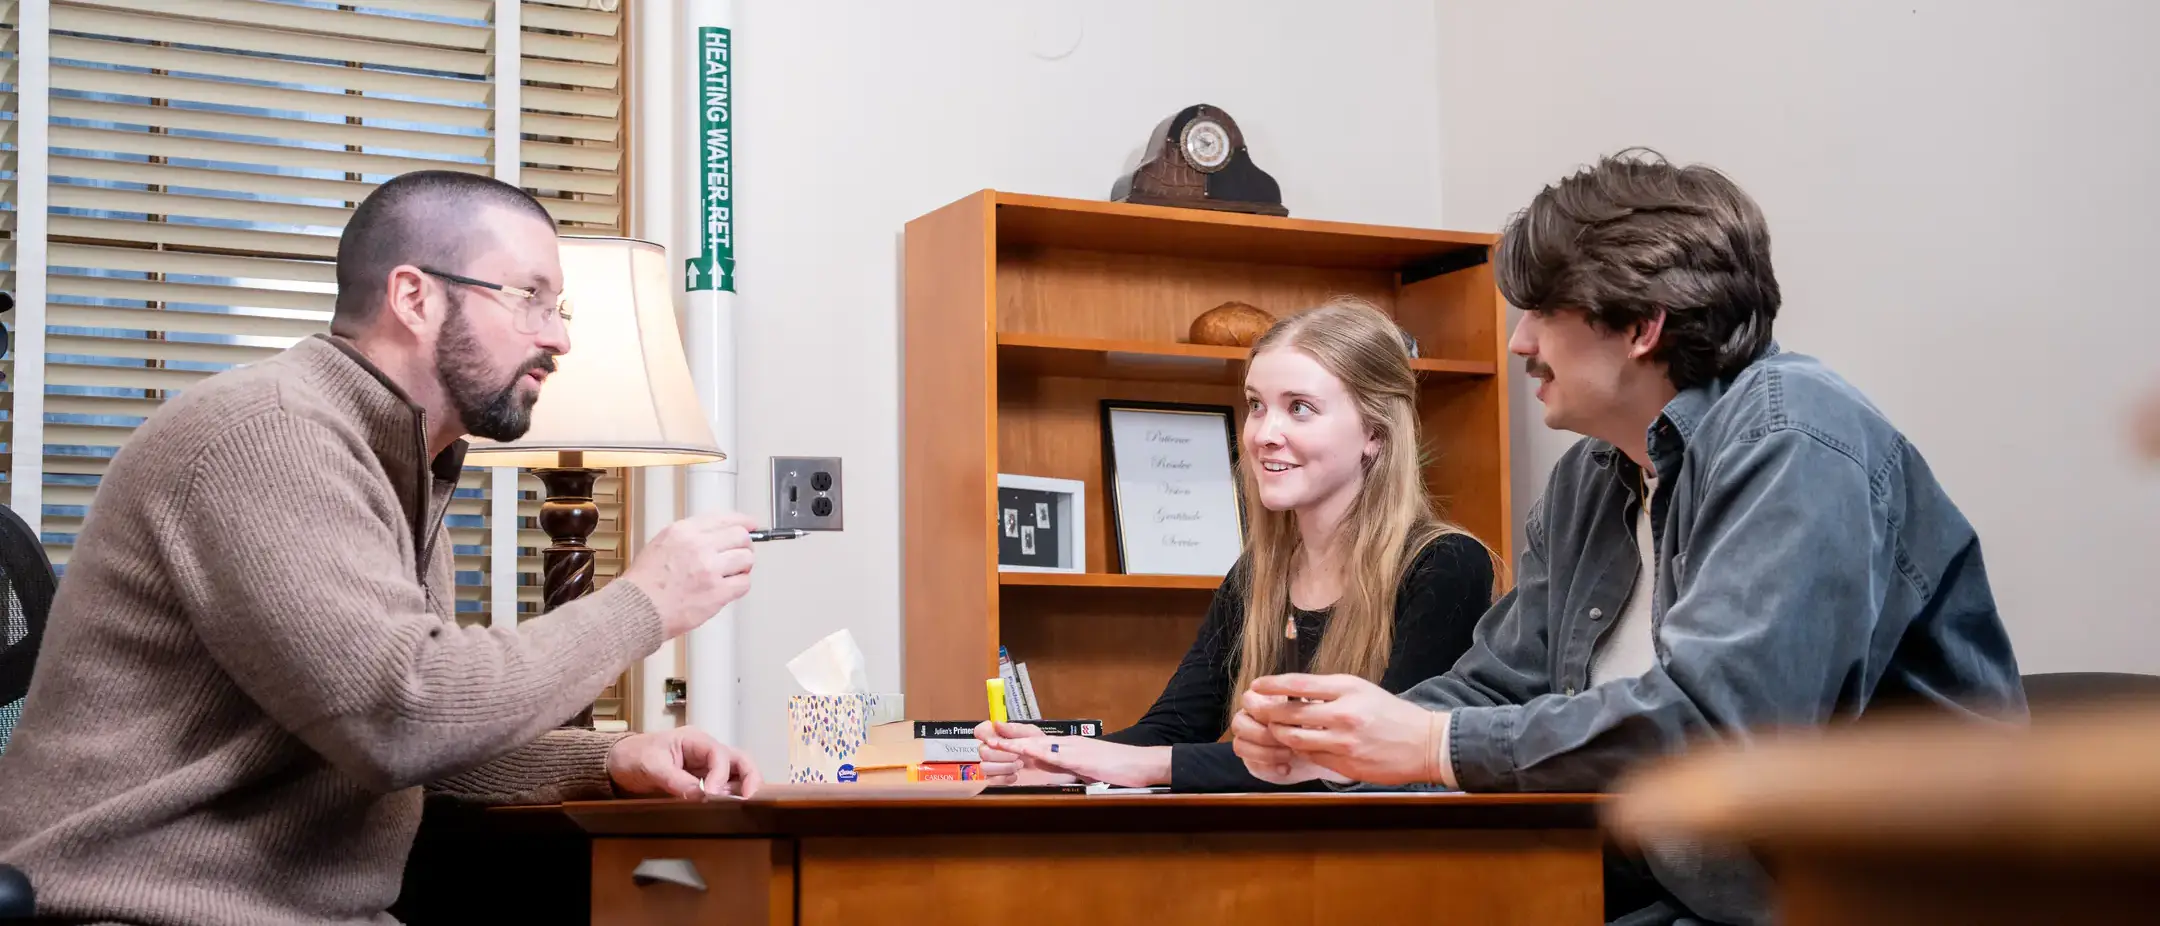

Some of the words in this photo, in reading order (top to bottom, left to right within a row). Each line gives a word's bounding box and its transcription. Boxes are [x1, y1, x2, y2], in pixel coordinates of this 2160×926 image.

[705, 32, 728, 122] HEATING
[706, 128, 729, 200] WATER
[1145, 429, 1192, 444] Patience
[934, 727, 952, 735] Julien's
[953, 726, 974, 735] Primer
